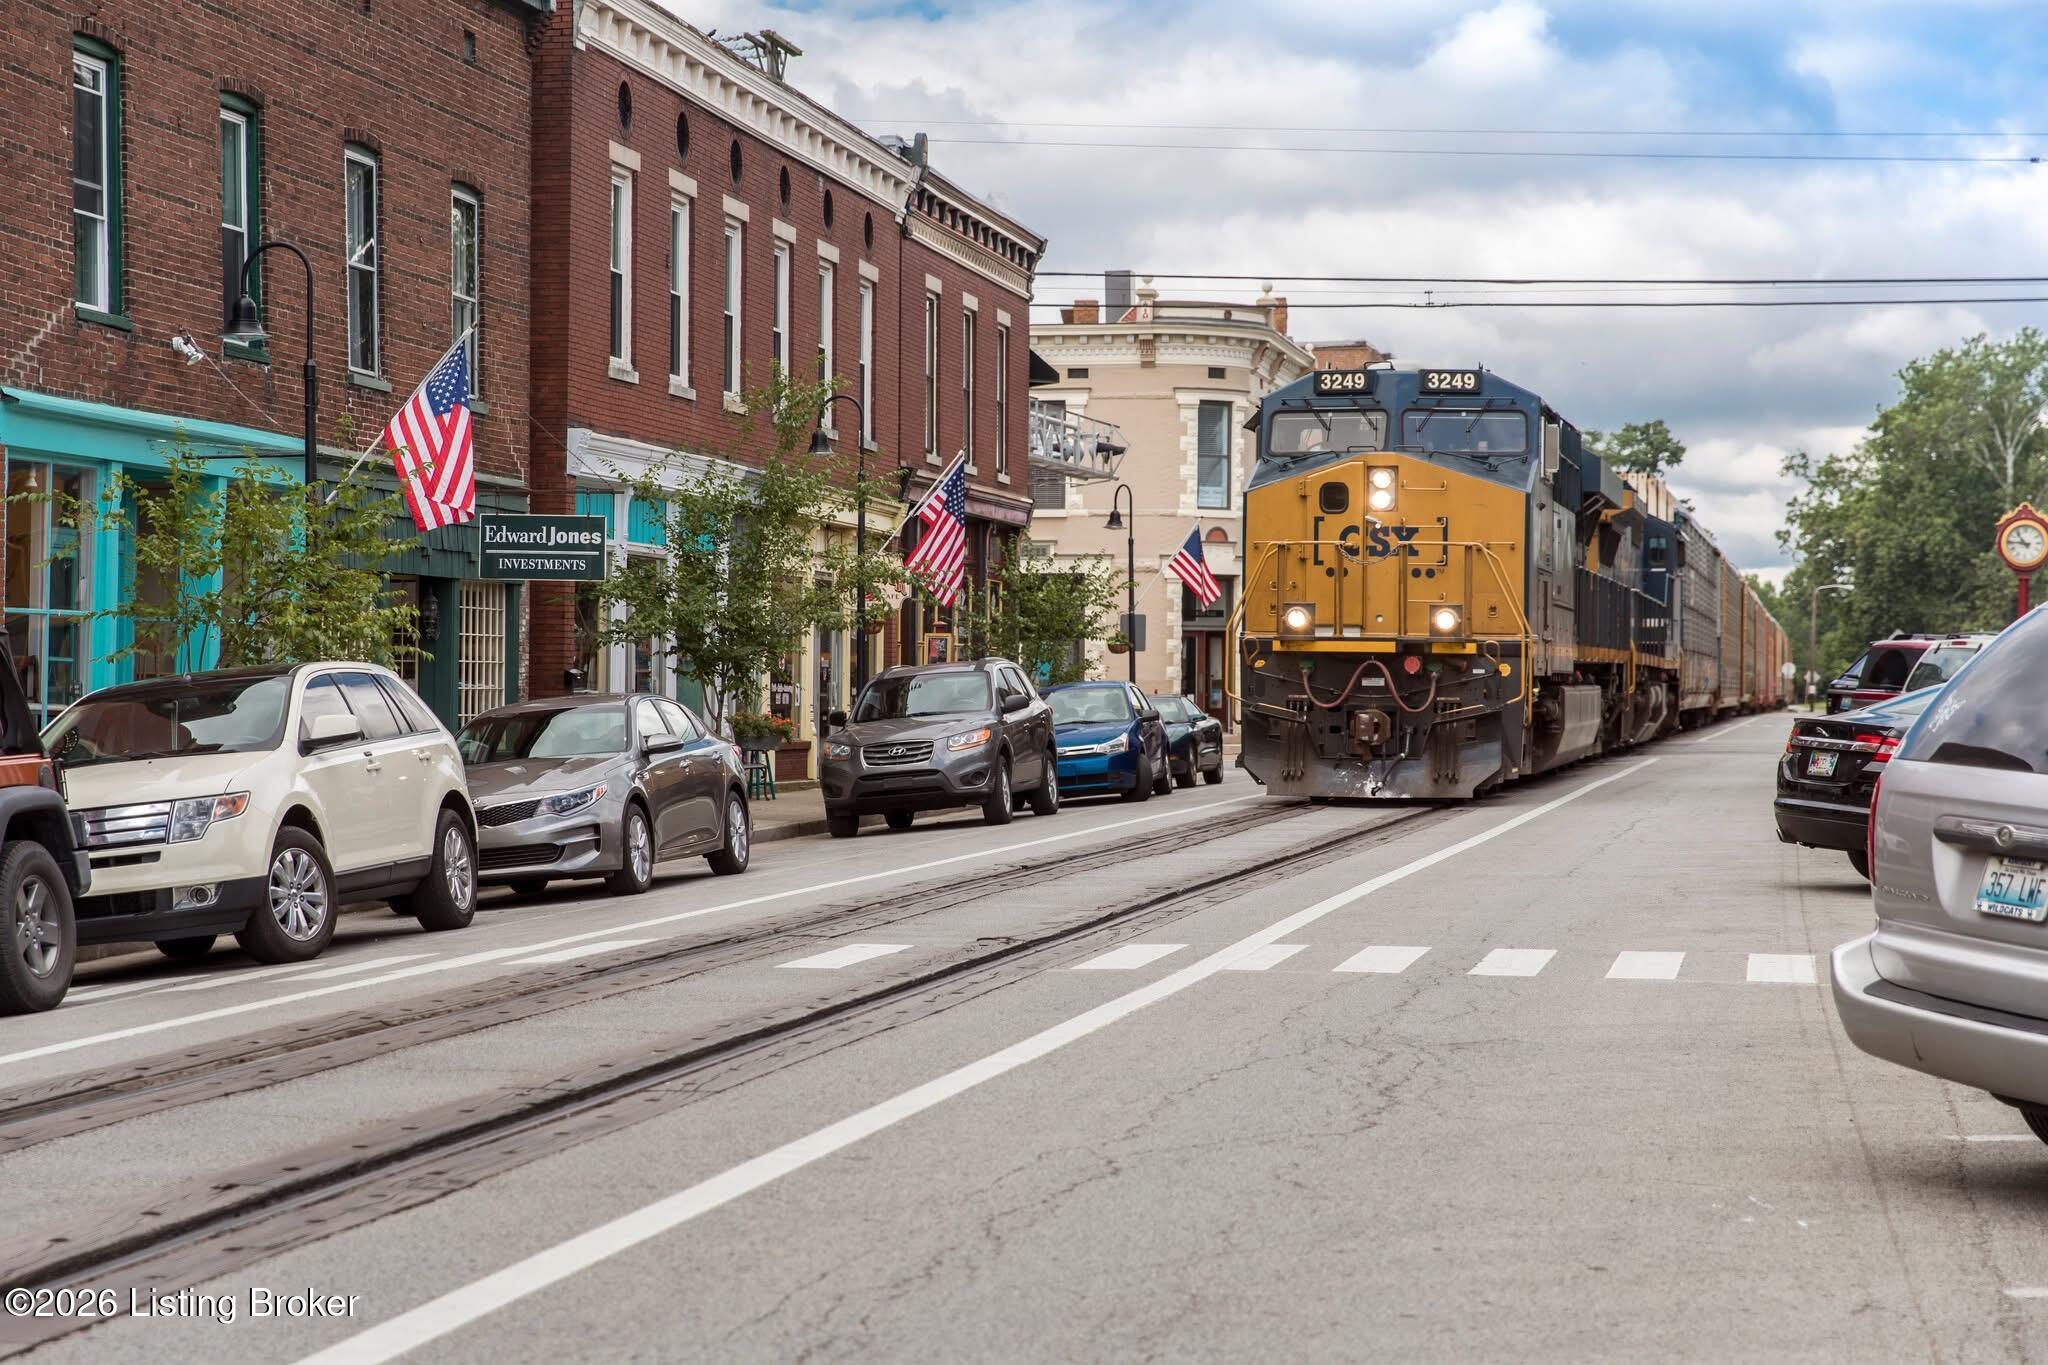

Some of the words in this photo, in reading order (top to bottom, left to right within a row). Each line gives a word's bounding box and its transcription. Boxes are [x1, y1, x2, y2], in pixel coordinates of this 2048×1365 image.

[1320, 373, 1365, 389] 3249
[1427, 372, 1475, 389] 3249
[1339, 525, 1419, 557] CSX
[499, 558, 586, 571] INVESTMENTS
[1985, 871, 2014, 899] 357
[1987, 903, 2024, 917] WILDCATS
